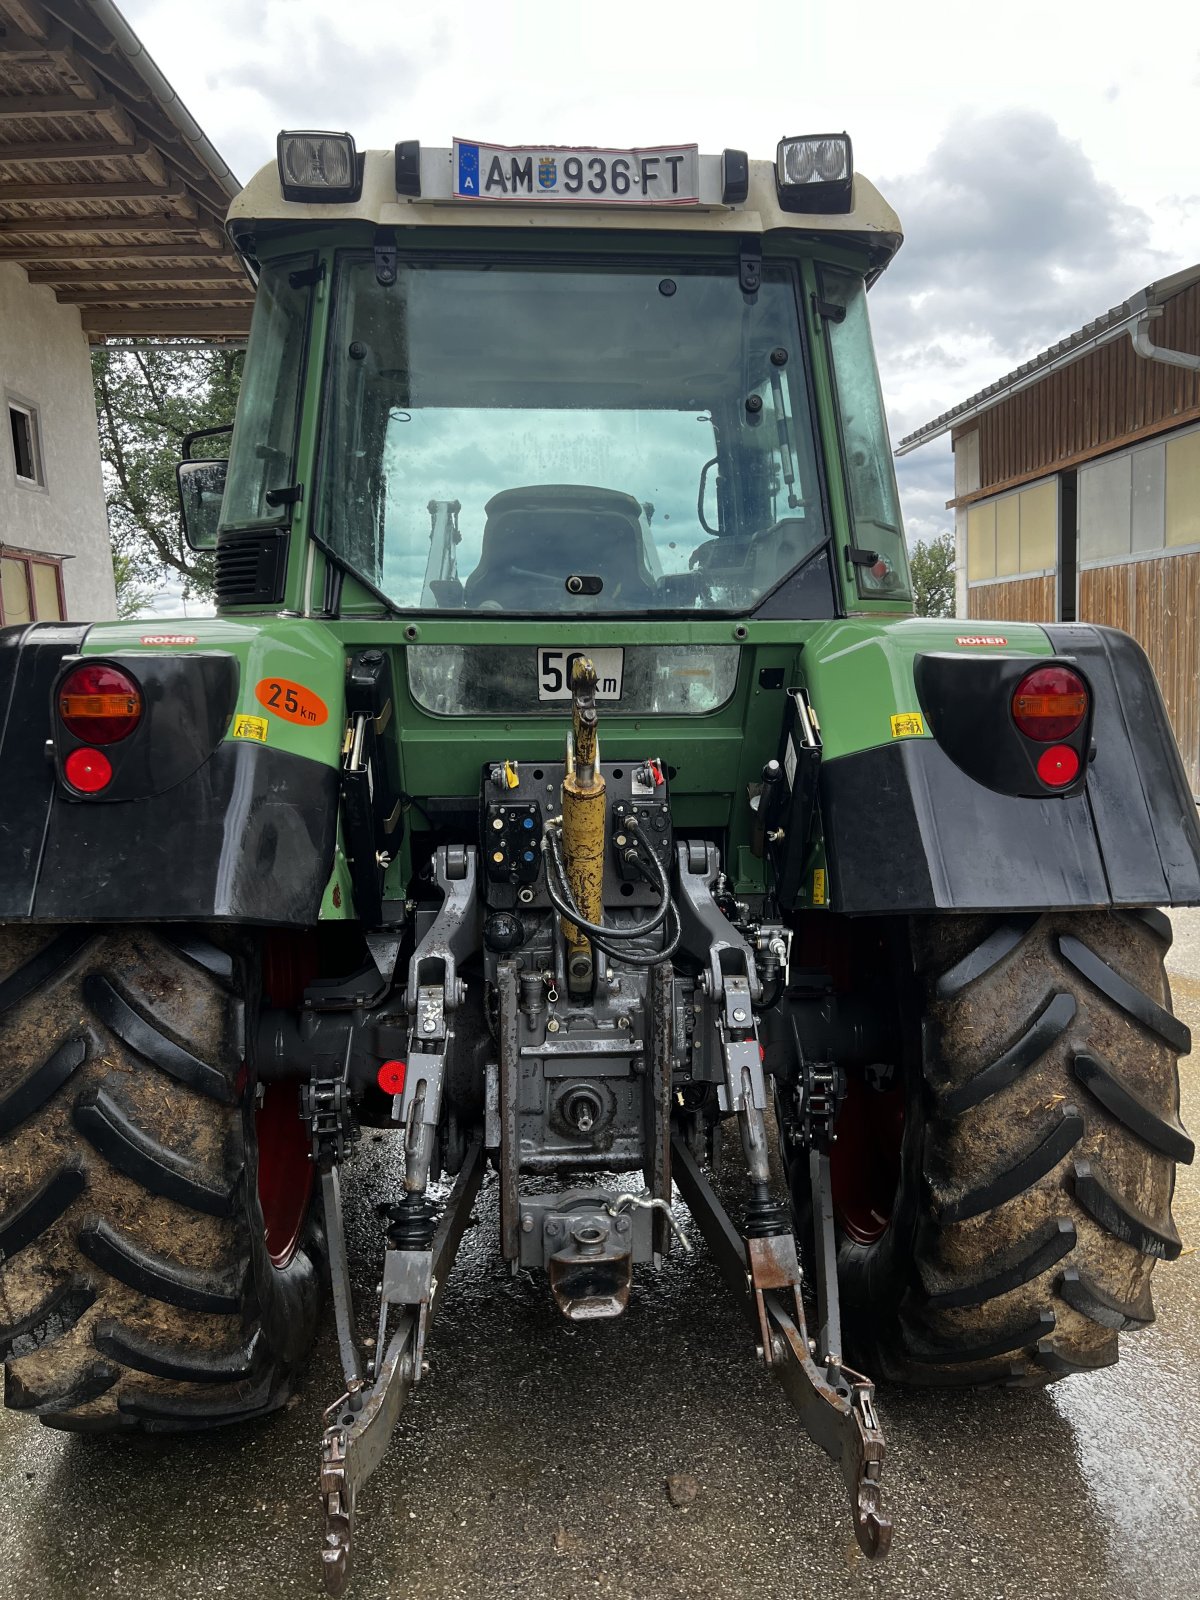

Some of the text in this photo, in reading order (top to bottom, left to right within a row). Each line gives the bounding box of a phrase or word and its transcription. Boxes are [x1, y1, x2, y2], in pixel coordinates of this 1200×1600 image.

[464, 177, 474, 189] A
[485, 155, 684, 195] AM 936 FT
[266, 683, 317, 722] 25 km
